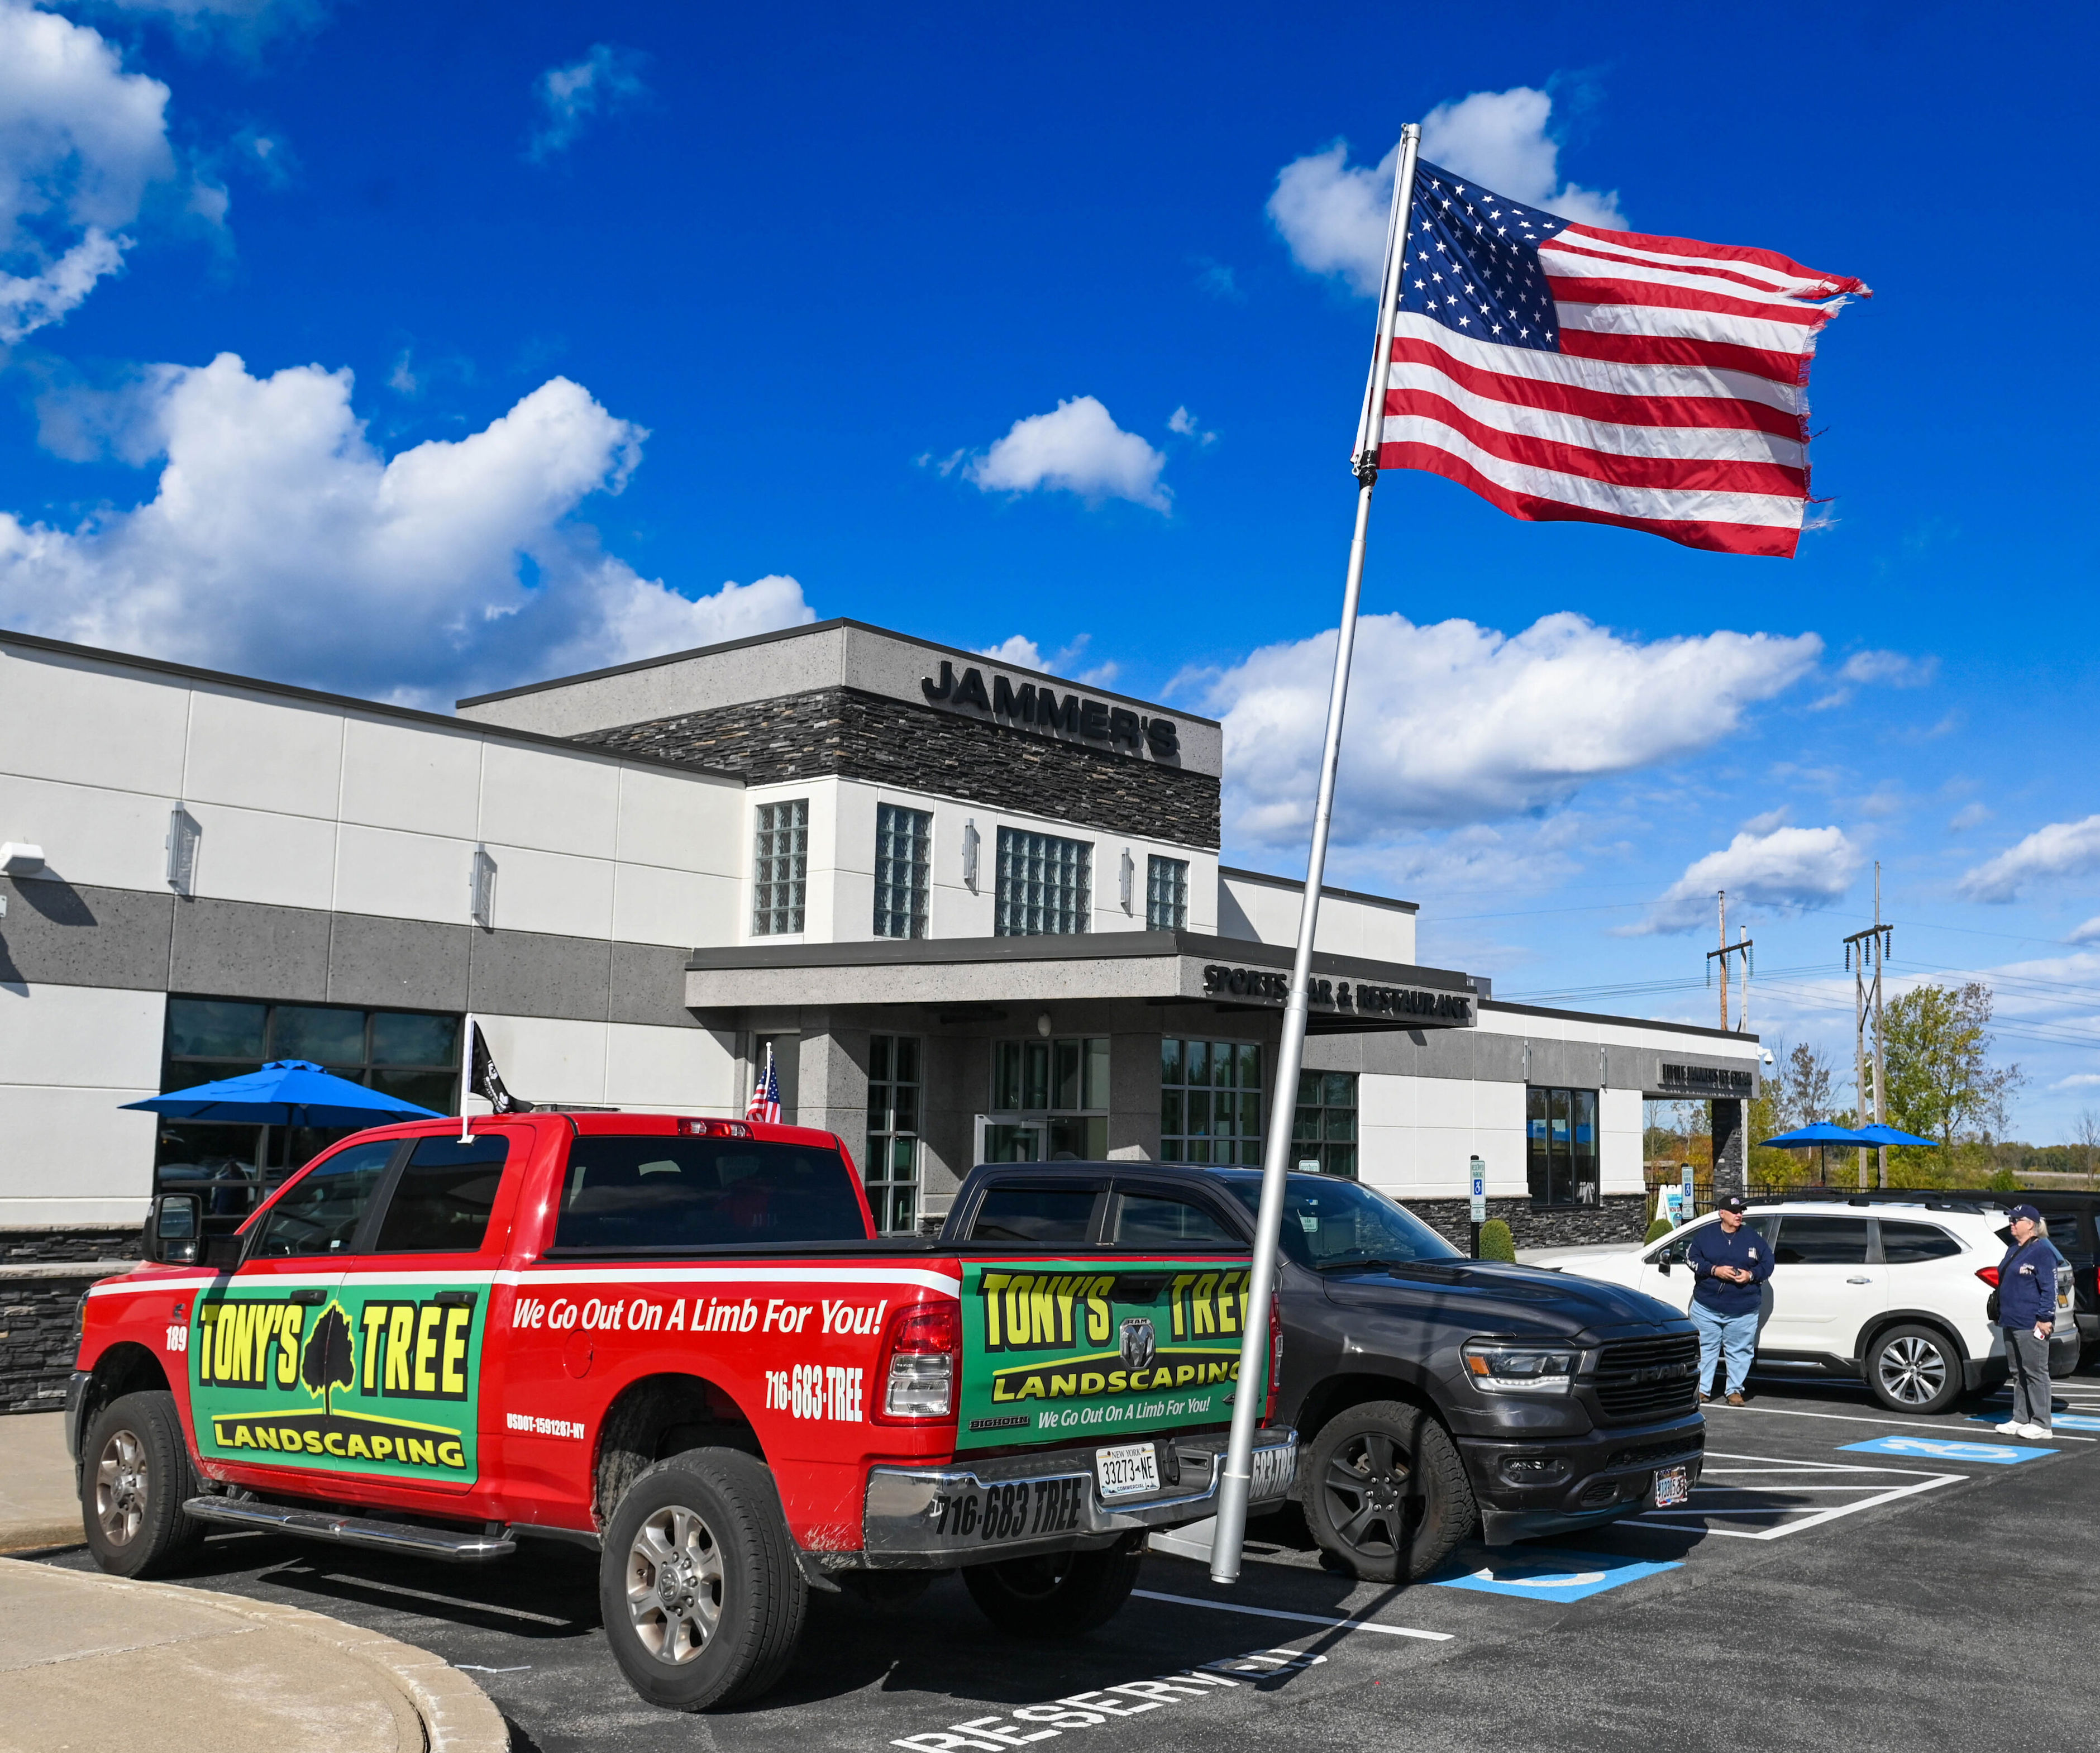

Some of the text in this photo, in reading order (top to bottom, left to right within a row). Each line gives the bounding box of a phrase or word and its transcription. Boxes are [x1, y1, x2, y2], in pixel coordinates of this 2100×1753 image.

[922, 661, 1177, 757] JAMMER'S
[1204, 965, 1470, 1019] SPORTS AR & RESTAURANT
[512, 1297, 888, 1335] We Go Out On A Limb For You!
[983, 1274, 1115, 1346] TONY'S
[166, 1326, 188, 1351] 189
[201, 1304, 470, 1393] TONY'S TREE
[765, 1364, 863, 1422] 716-683-TREE
[1038, 1412, 1058, 1428] We
[1061, 1410, 1078, 1426] Go
[1081, 1407, 1104, 1424] Out
[1105, 1406, 1123, 1422] On
[1124, 1404, 1134, 1420] A
[1136, 1402, 1164, 1418] Limb
[1166, 1400, 1188, 1416] For
[1187, 1397, 1211, 1413] You!
[214, 1423, 465, 1468] LANDSCAPING
[507, 1413, 585, 1440] USDOT-1591287-NY
[971, 1416, 1029, 1428] BIGHORN
[1111, 1448, 1141, 1459] NEW YORK
[936, 1478, 1082, 1540] 716-683 TREE
[890, 1649, 1328, 1753] RESERVED
